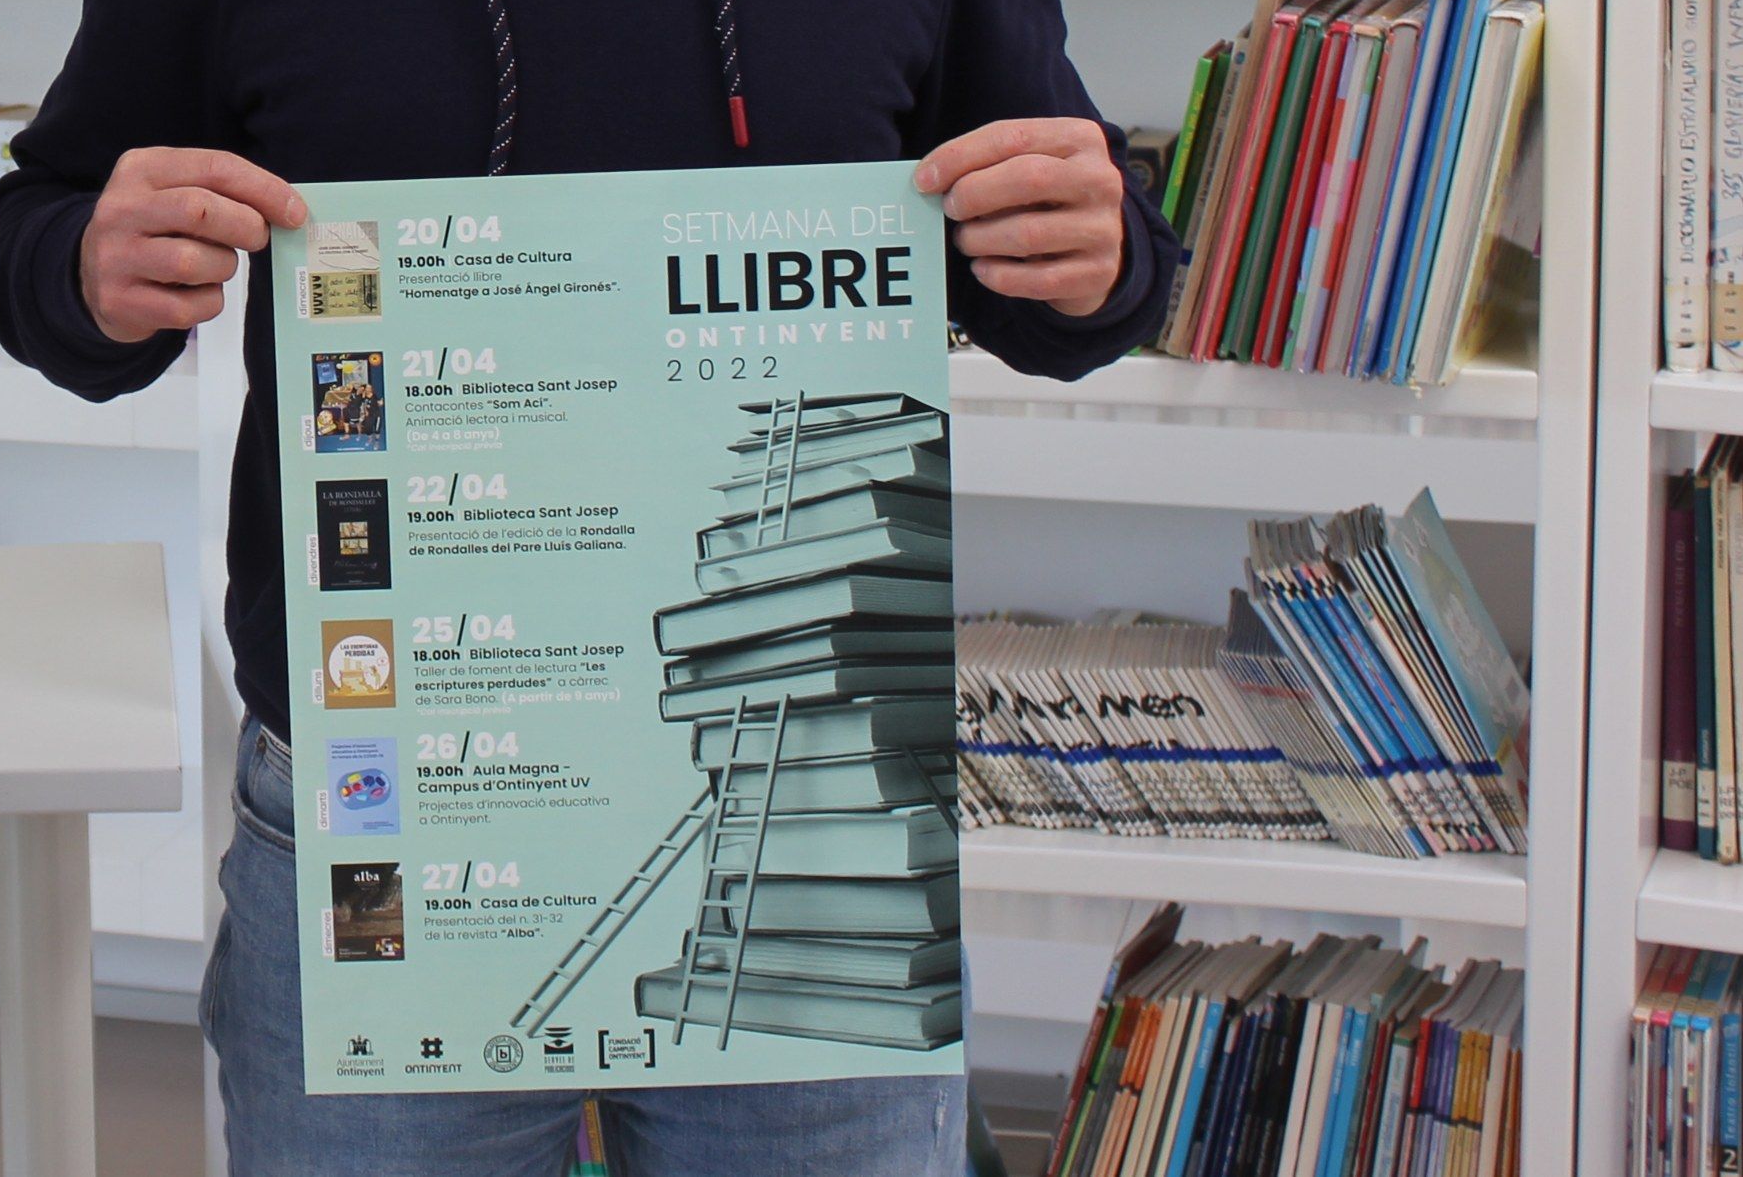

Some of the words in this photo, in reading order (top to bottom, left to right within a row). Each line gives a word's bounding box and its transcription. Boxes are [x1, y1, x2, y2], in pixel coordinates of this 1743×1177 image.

[397, 215, 502, 248] 20/04
[663, 209, 836, 244] SETMANA
[852, 205, 915, 236] DEL
[398, 256, 445, 268] 19.00h
[454, 254, 493, 266] Casa
[496, 253, 514, 265] de
[518, 251, 572, 264] Cultura
[666, 246, 912, 315] LLIBRE
[666, 320, 914, 347] ONTINYENT
[402, 347, 496, 381] 21/04
[667, 356, 778, 381] 2022
[405, 385, 452, 397] 18.00h
[462, 382, 534, 395] Biblioteca
[537, 380, 570, 392] Sant
[574, 379, 617, 392] Josep
[405, 400, 484, 413] Contacontes
[406, 414, 463, 427] Animació
[466, 413, 508, 425] lectora
[519, 411, 568, 423] musical.
[408, 473, 507, 506] 22/04
[408, 511, 454, 522] 19.00h
[464, 508, 535, 521] Biblioteca
[539, 507, 572, 518] Sant
[576, 505, 619, 520] Josep
[412, 614, 515, 646] 25/04
[413, 650, 460, 662] 18.00h
[470, 647, 542, 660] Biblioteca
[545, 645, 578, 657] Sant
[581, 644, 624, 658] Josep
[417, 731, 519, 763] 26/04
[417, 766, 463, 778] 19.00h
[473, 764, 506, 775] Aula
[509, 763, 559, 777] Magna
[418, 781, 480, 796] Campus
[571, 777, 591, 788] UV
[423, 861, 521, 893] 27/04
[426, 898, 471, 910] 19.00h
[481, 896, 519, 908] Casa
[523, 895, 540, 907] de
[543, 893, 597, 907] Cultura
[1727, 1043, 1737, 1093] Infantil
[1725, 1099, 1738, 1139] Teatro
[1722, 1148, 1737, 1168] 2
